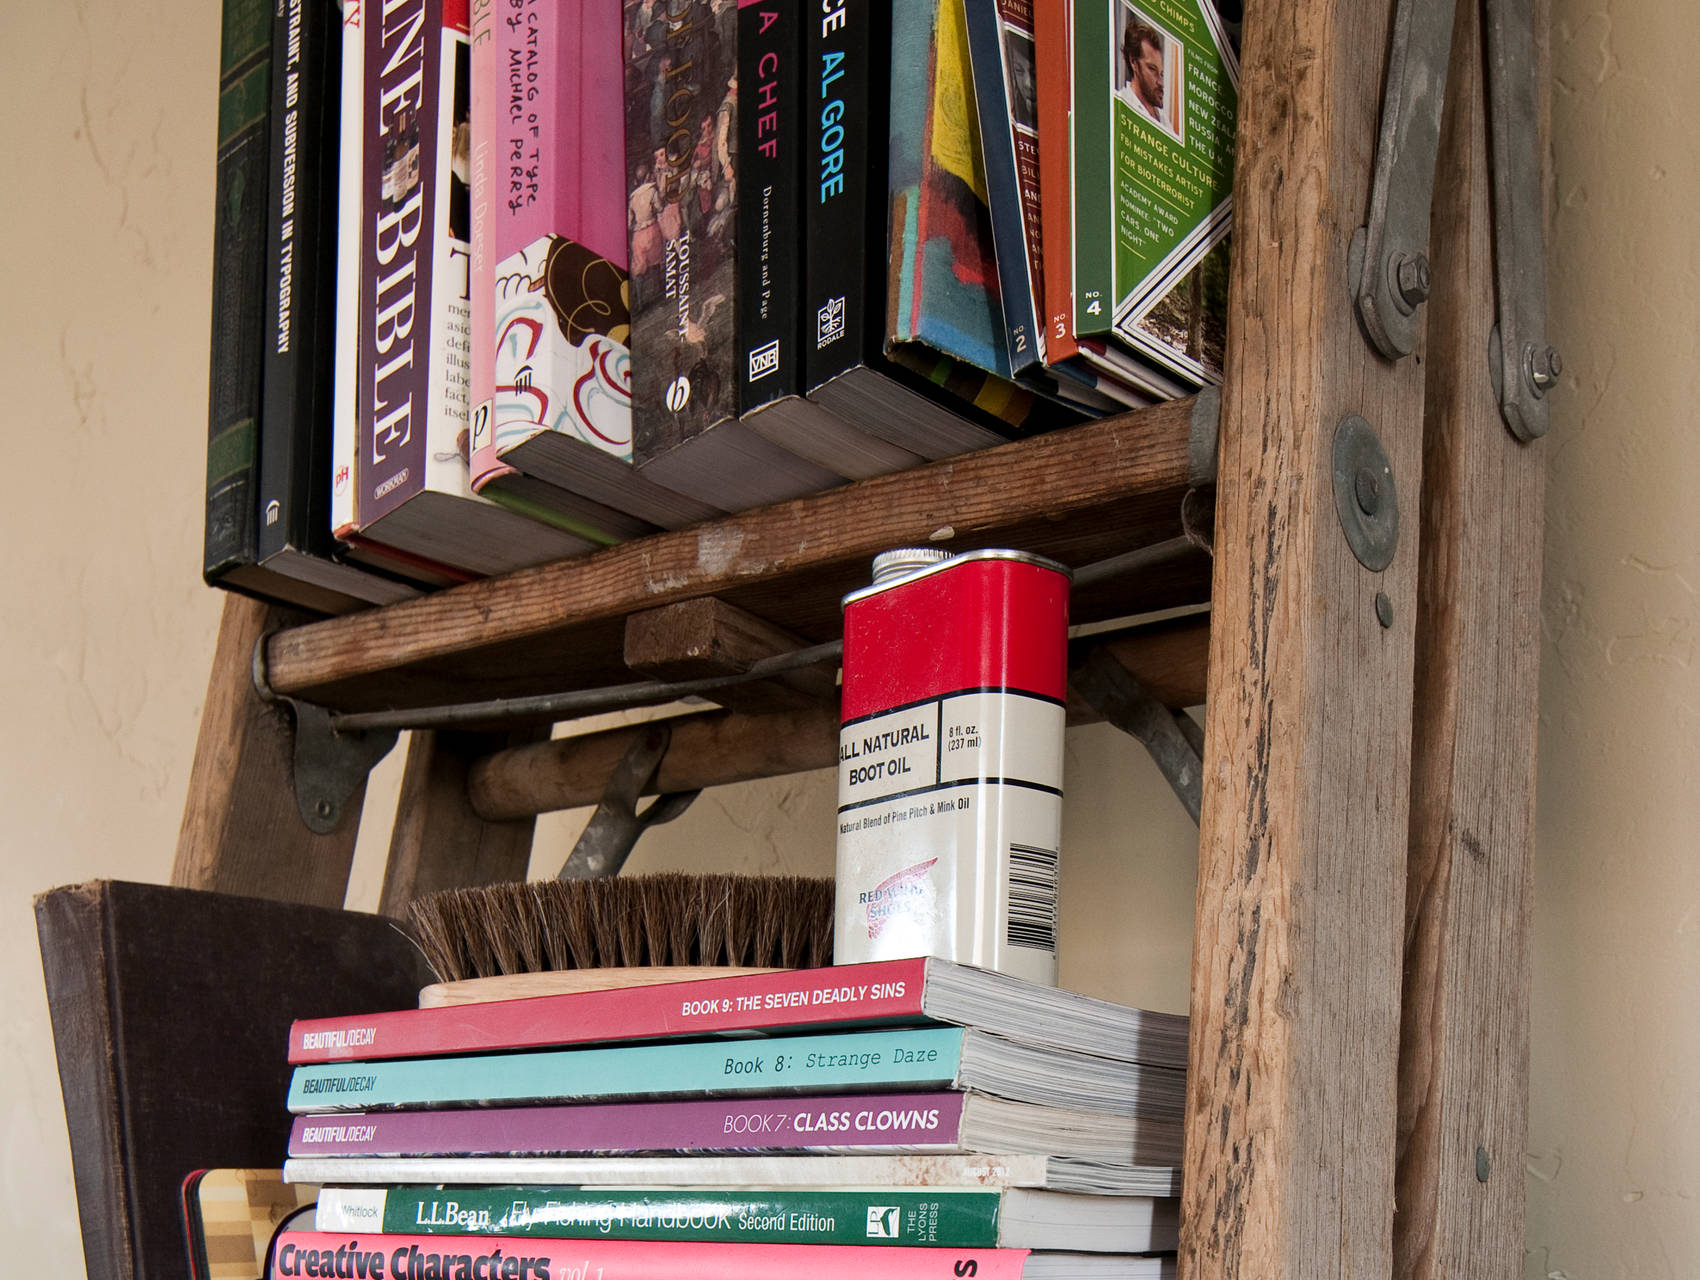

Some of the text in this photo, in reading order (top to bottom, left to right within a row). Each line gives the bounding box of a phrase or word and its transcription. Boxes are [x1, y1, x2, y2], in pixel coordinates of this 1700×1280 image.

[527, 12, 540, 102] CATALOG
[285, 72, 300, 109] AND
[757, 12, 780, 158] A CHEF
[527, 113, 540, 139] OF
[664, 59, 694, 203] FOOD
[820, 51, 845, 204] AL GORE
[1120, 113, 1169, 157] STRANGE
[1188, 134, 1207, 154] THE
[282, 110, 298, 219] SUBVERSION
[471, 141, 488, 193] Linda
[1120, 151, 1195, 209] FOR BIOTERRORIST
[1133, 144, 1174, 178] MISTAKES
[1175, 174, 1204, 198] ARTIST
[281, 219, 294, 241] IN
[1144, 226, 1160, 243] ONE
[664, 240, 677, 300] SAMAT
[760, 185, 772, 320] Dornenburg and Page
[277, 241, 293, 354] TYPOGRAPHY
[1086, 300, 1102, 315] 4
[372, 181, 424, 466] BIBLE
[817, 329, 845, 350] RODALE
[1055, 323, 1067, 339] 3
[1014, 335, 1027, 352] 2
[840, 723, 930, 763] ALL NATURAL
[955, 725, 964, 737] fl.
[965, 725, 979, 736] oz.
[849, 756, 912, 786] BOOT OIL
[839, 796, 970, 836] Natural Blend of Pine Pitch & Mink Oil
[859, 890, 883, 905] RED
[681, 980, 907, 1017] BOOK 9: THE SEVEN DEADLY SINS
[303, 1027, 377, 1051] BEAUTIFUL/DECAY
[724, 1047, 938, 1076] Book 8: Strange Daze
[303, 1075, 377, 1096] BEAUTIFUL/DECAY
[302, 1125, 377, 1144] BEAUTIFUL/DECAY
[793, 1111, 851, 1133] CLASS
[854, 1109, 940, 1132] CLOWNS
[341, 1202, 378, 1219] Whitlock
[738, 1212, 786, 1232] Second
[790, 1213, 835, 1232] Edition
[907, 1210, 917, 1234] THE
[918, 1203, 928, 1242] LYONS
[929, 1202, 939, 1242] PRESS
[279, 1240, 384, 1280] Creative
